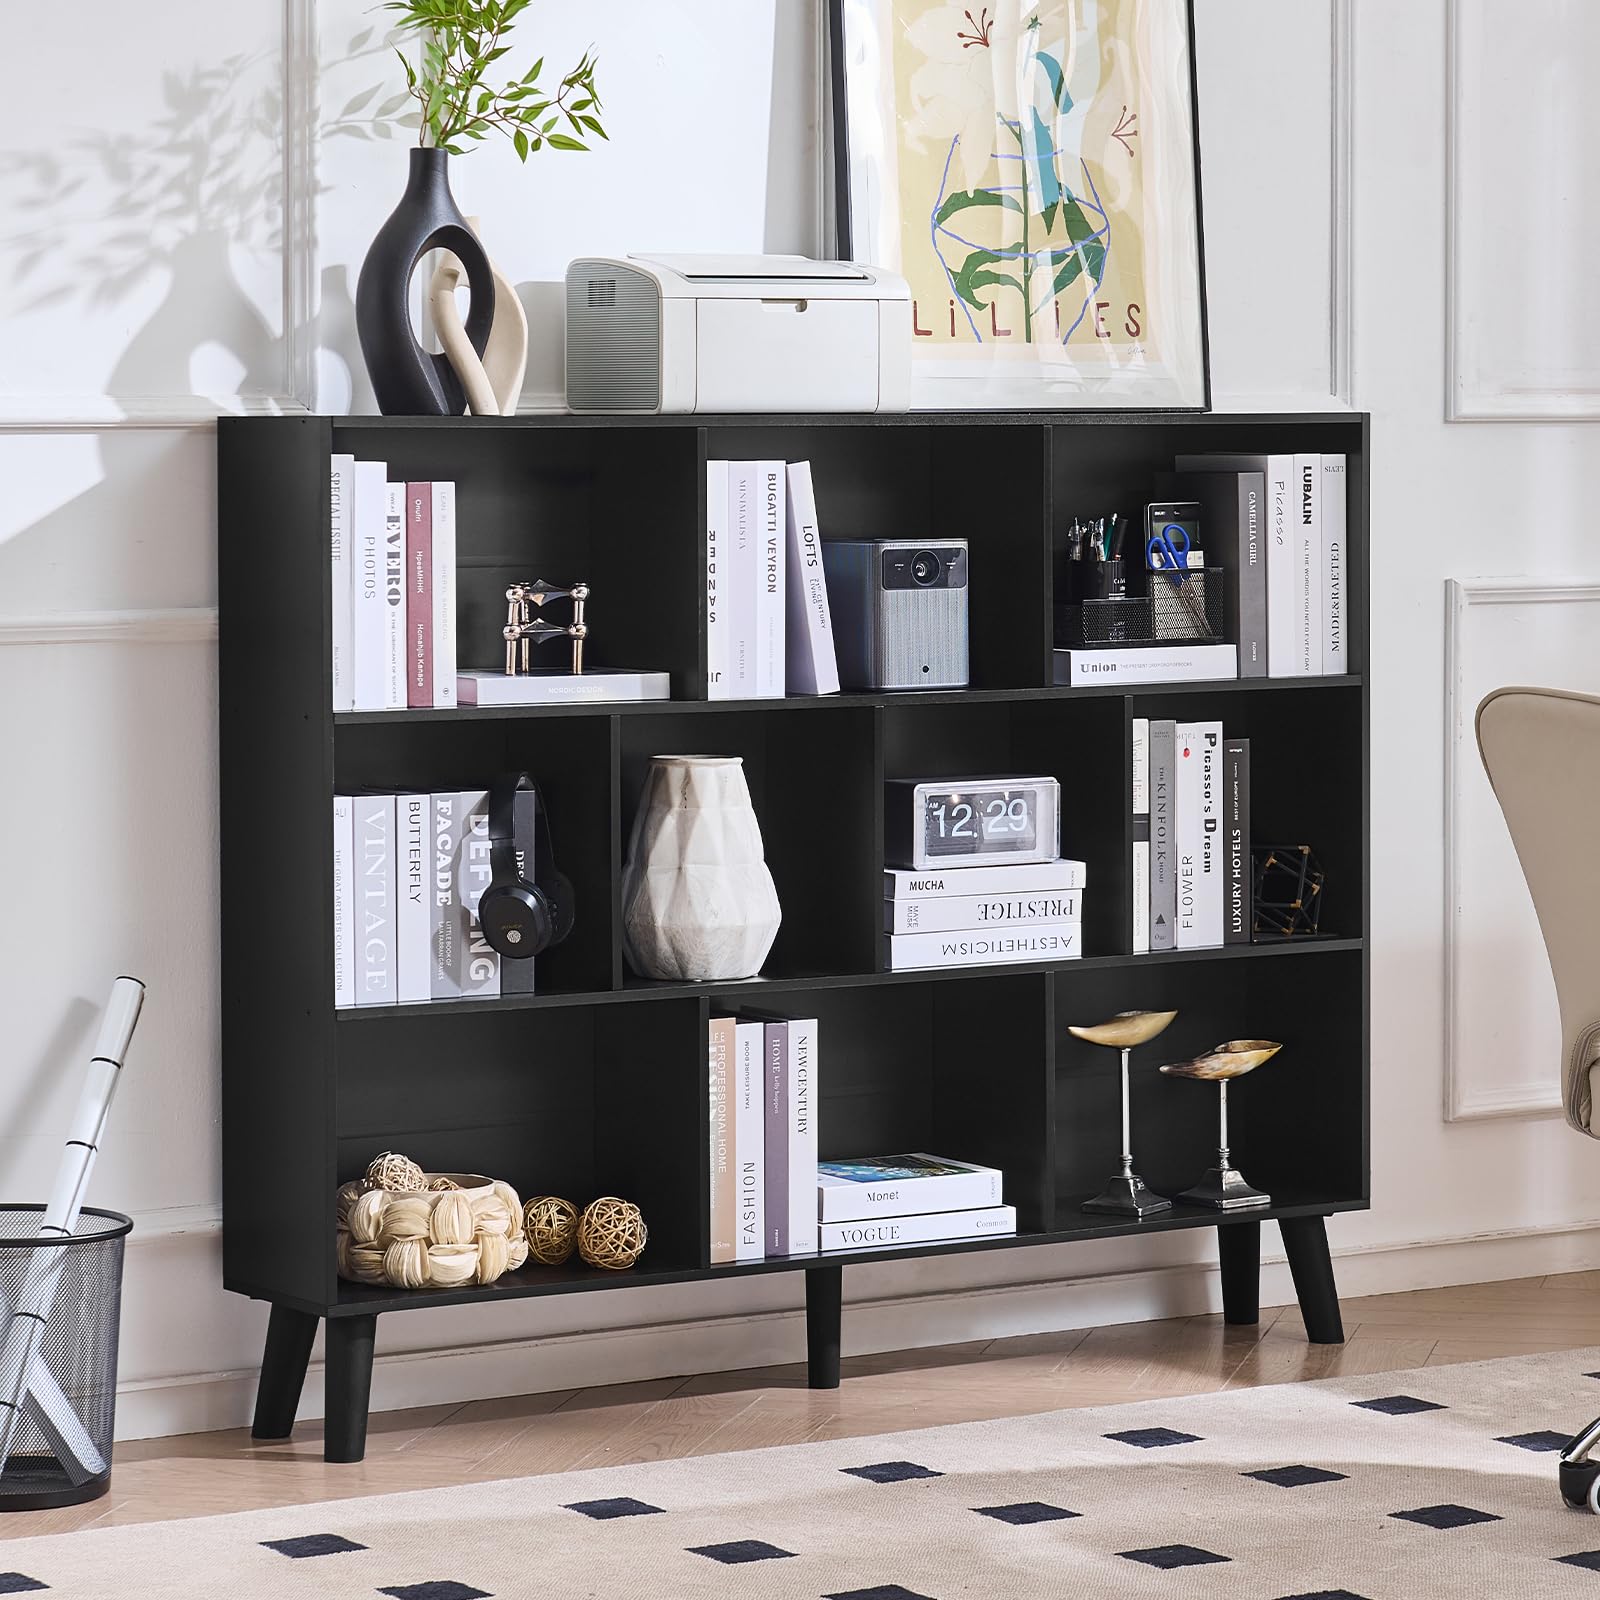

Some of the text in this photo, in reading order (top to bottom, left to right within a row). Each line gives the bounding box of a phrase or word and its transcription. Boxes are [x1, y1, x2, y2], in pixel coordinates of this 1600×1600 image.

[414, 498, 423, 523] Onufri
[1275, 480, 1287, 547] Picasso
[1302, 465, 1313, 525] LUBALIN
[767, 472, 777, 594] BUGATTI VEYRON
[802, 525, 818, 568] LOFTS
[1248, 491, 1258, 567] CAMELLIA GIRL
[364, 536, 376, 600] PHOTOS
[386, 515, 402, 607] EVERO
[809, 579, 819, 605] LIVING
[816, 593, 827, 630] CENTURY
[1080, 662, 1117, 673] Union
[928, 802, 945, 810] AM
[1157, 783, 1167, 862] KINFOLK
[1203, 732, 1218, 874] Picasso's Dream
[408, 800, 421, 904] BUTTERFLY
[436, 799, 453, 907] FACADE
[1231, 828, 1241, 878] HOTELS
[364, 808, 387, 993] VINTAGE
[909, 880, 945, 892] MUCHA
[977, 899, 1074, 922] PRESTIGE
[1181, 856, 1194, 929] FLOWER
[1232, 882, 1242, 933] LUXURY
[912, 905, 920, 929] MAYE
[335, 934, 343, 992] COLLECTION
[942, 935, 1073, 956] AESTHETICISM
[771, 1039, 781, 1074] HOME
[717, 1044, 727, 1137] PROFESSIONAL
[797, 1035, 808, 1136] NEWCENTURY
[717, 1138, 727, 1174] HOME
[742, 1161, 756, 1246] FASHION
[867, 1190, 899, 1202] Monet
[840, 1225, 900, 1243] VOGUE
